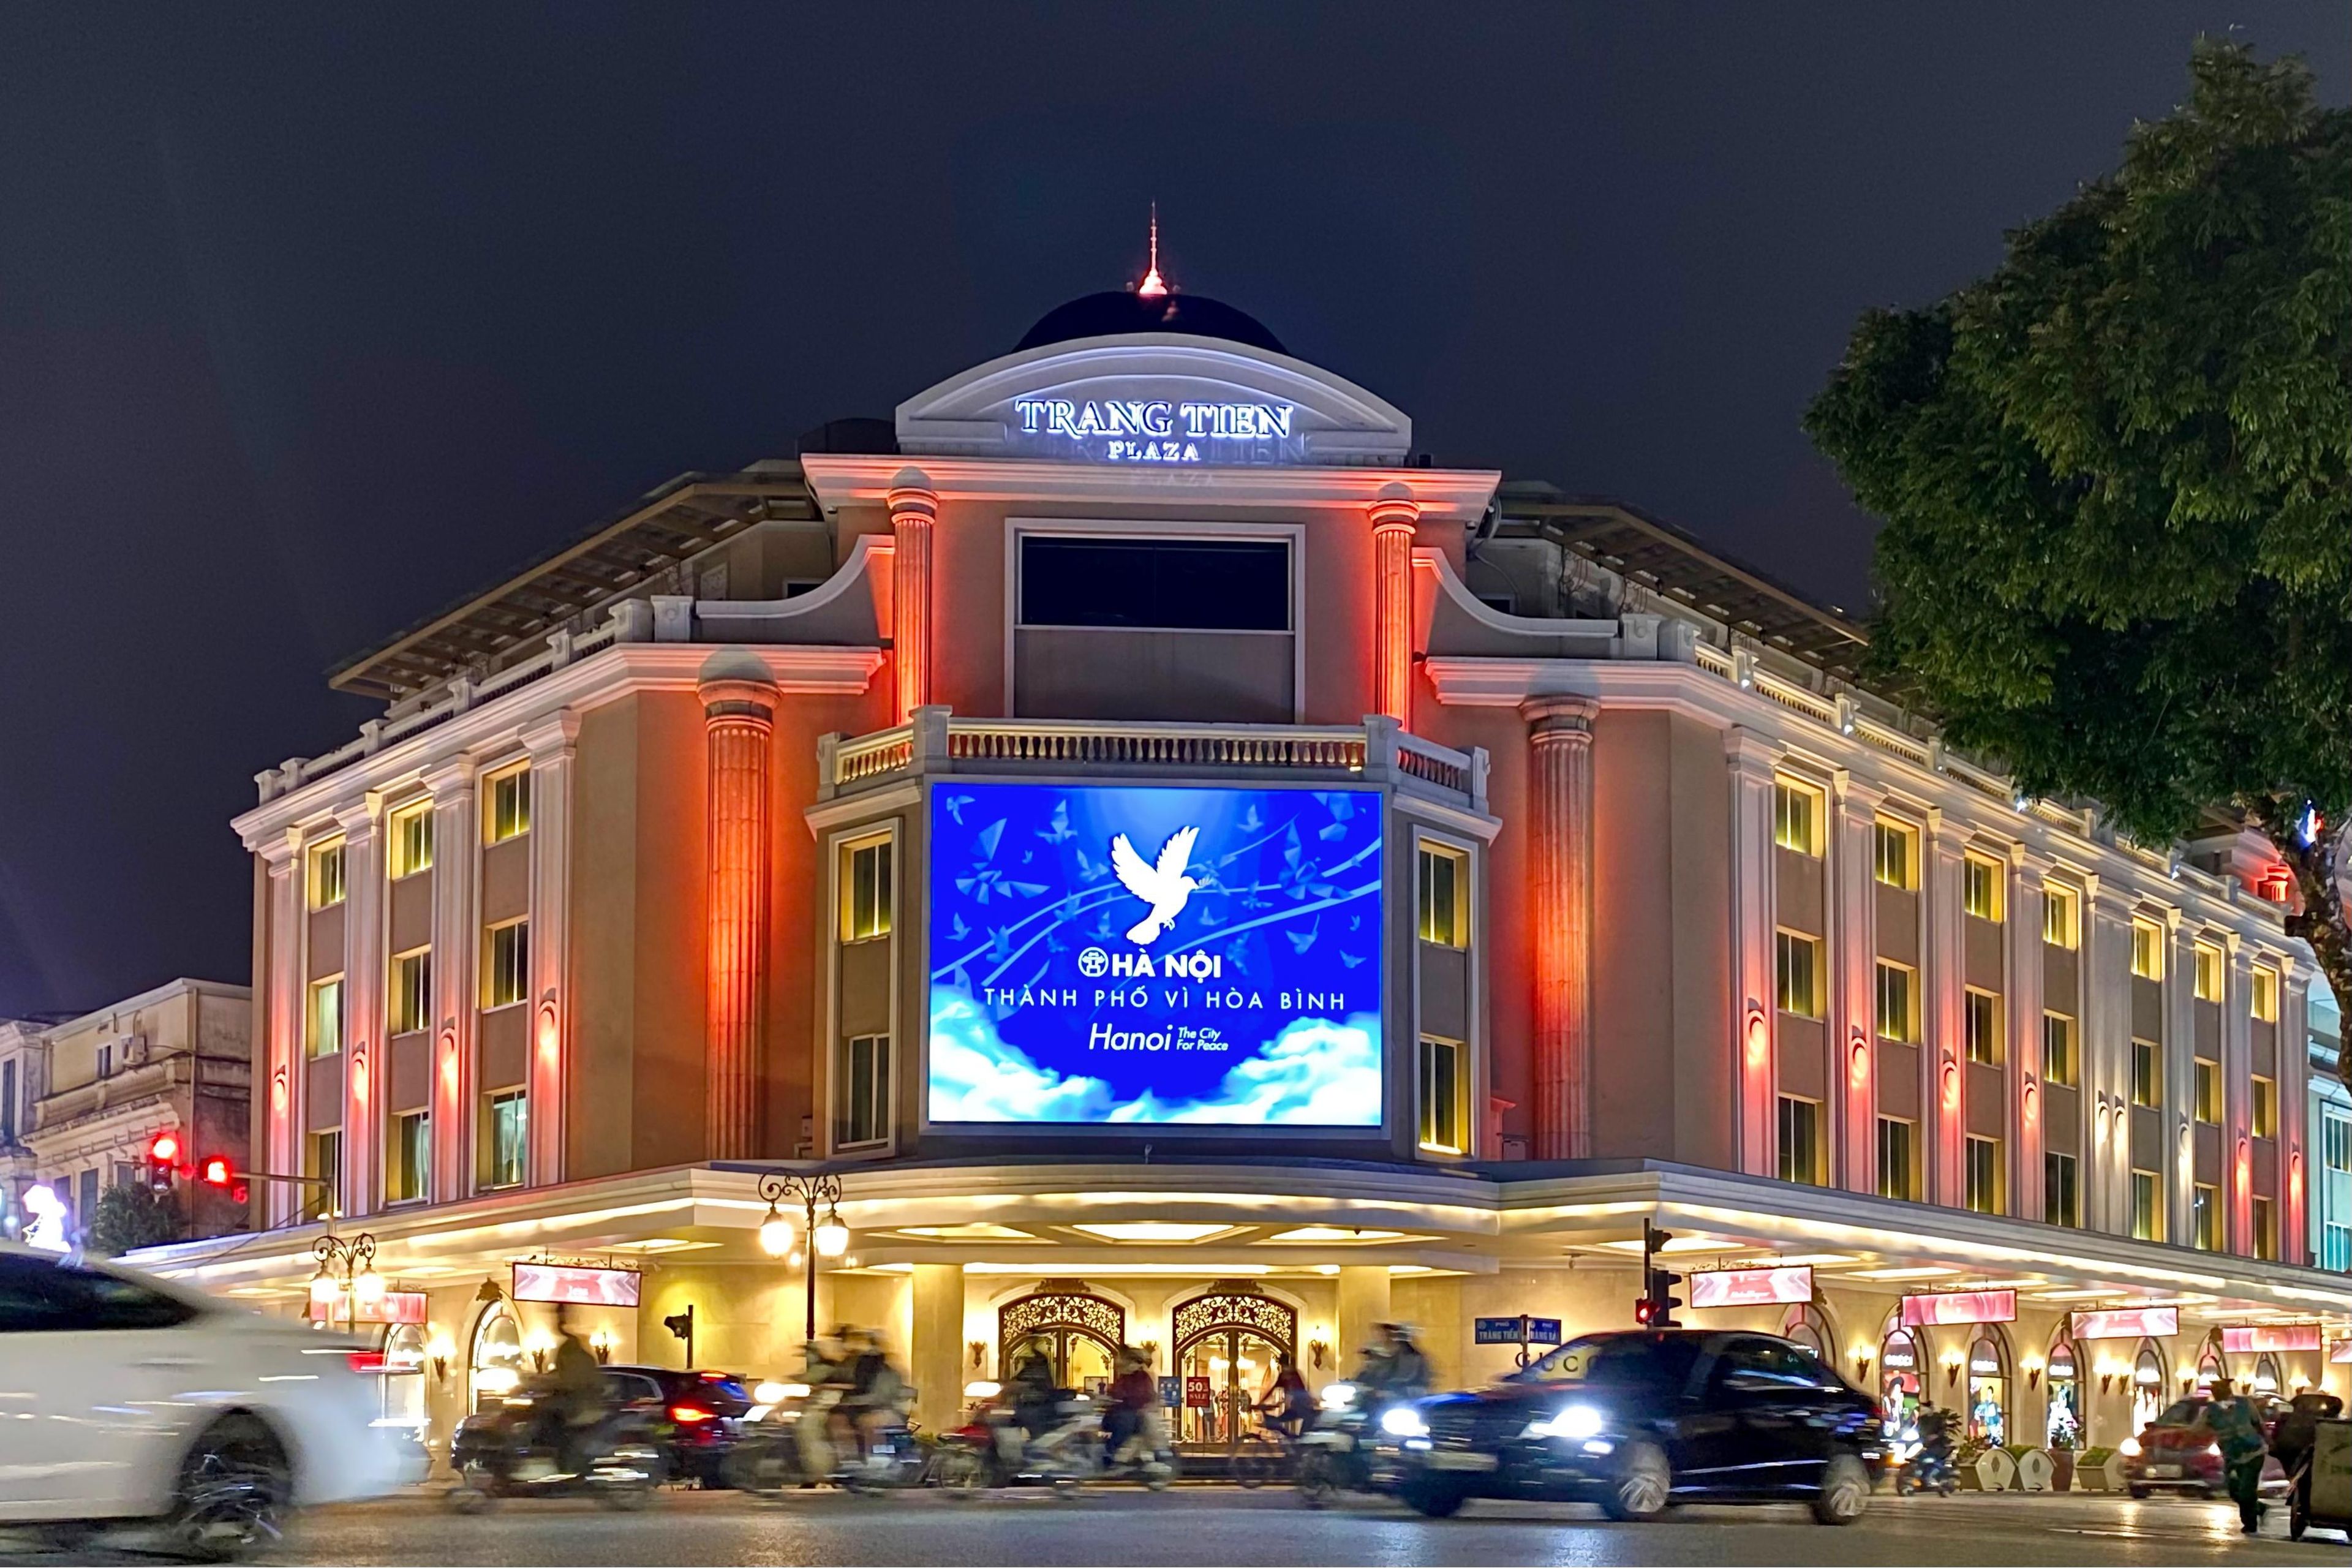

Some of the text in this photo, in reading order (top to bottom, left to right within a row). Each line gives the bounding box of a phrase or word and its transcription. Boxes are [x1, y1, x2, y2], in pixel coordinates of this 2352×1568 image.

[1015, 399, 1294, 439] TRANG TIEN
[1108, 440, 1201, 461] PLAZA
[1112, 948, 1221, 984] HÀ NỘI
[984, 984, 1344, 1010] THÀNH PHỐ VÌ HÒA BÌNH
[1088, 1023, 1174, 1051] Hanoi
[1176, 1039, 1229, 1051] For Peace
[1178, 1027, 1221, 1042] The City
